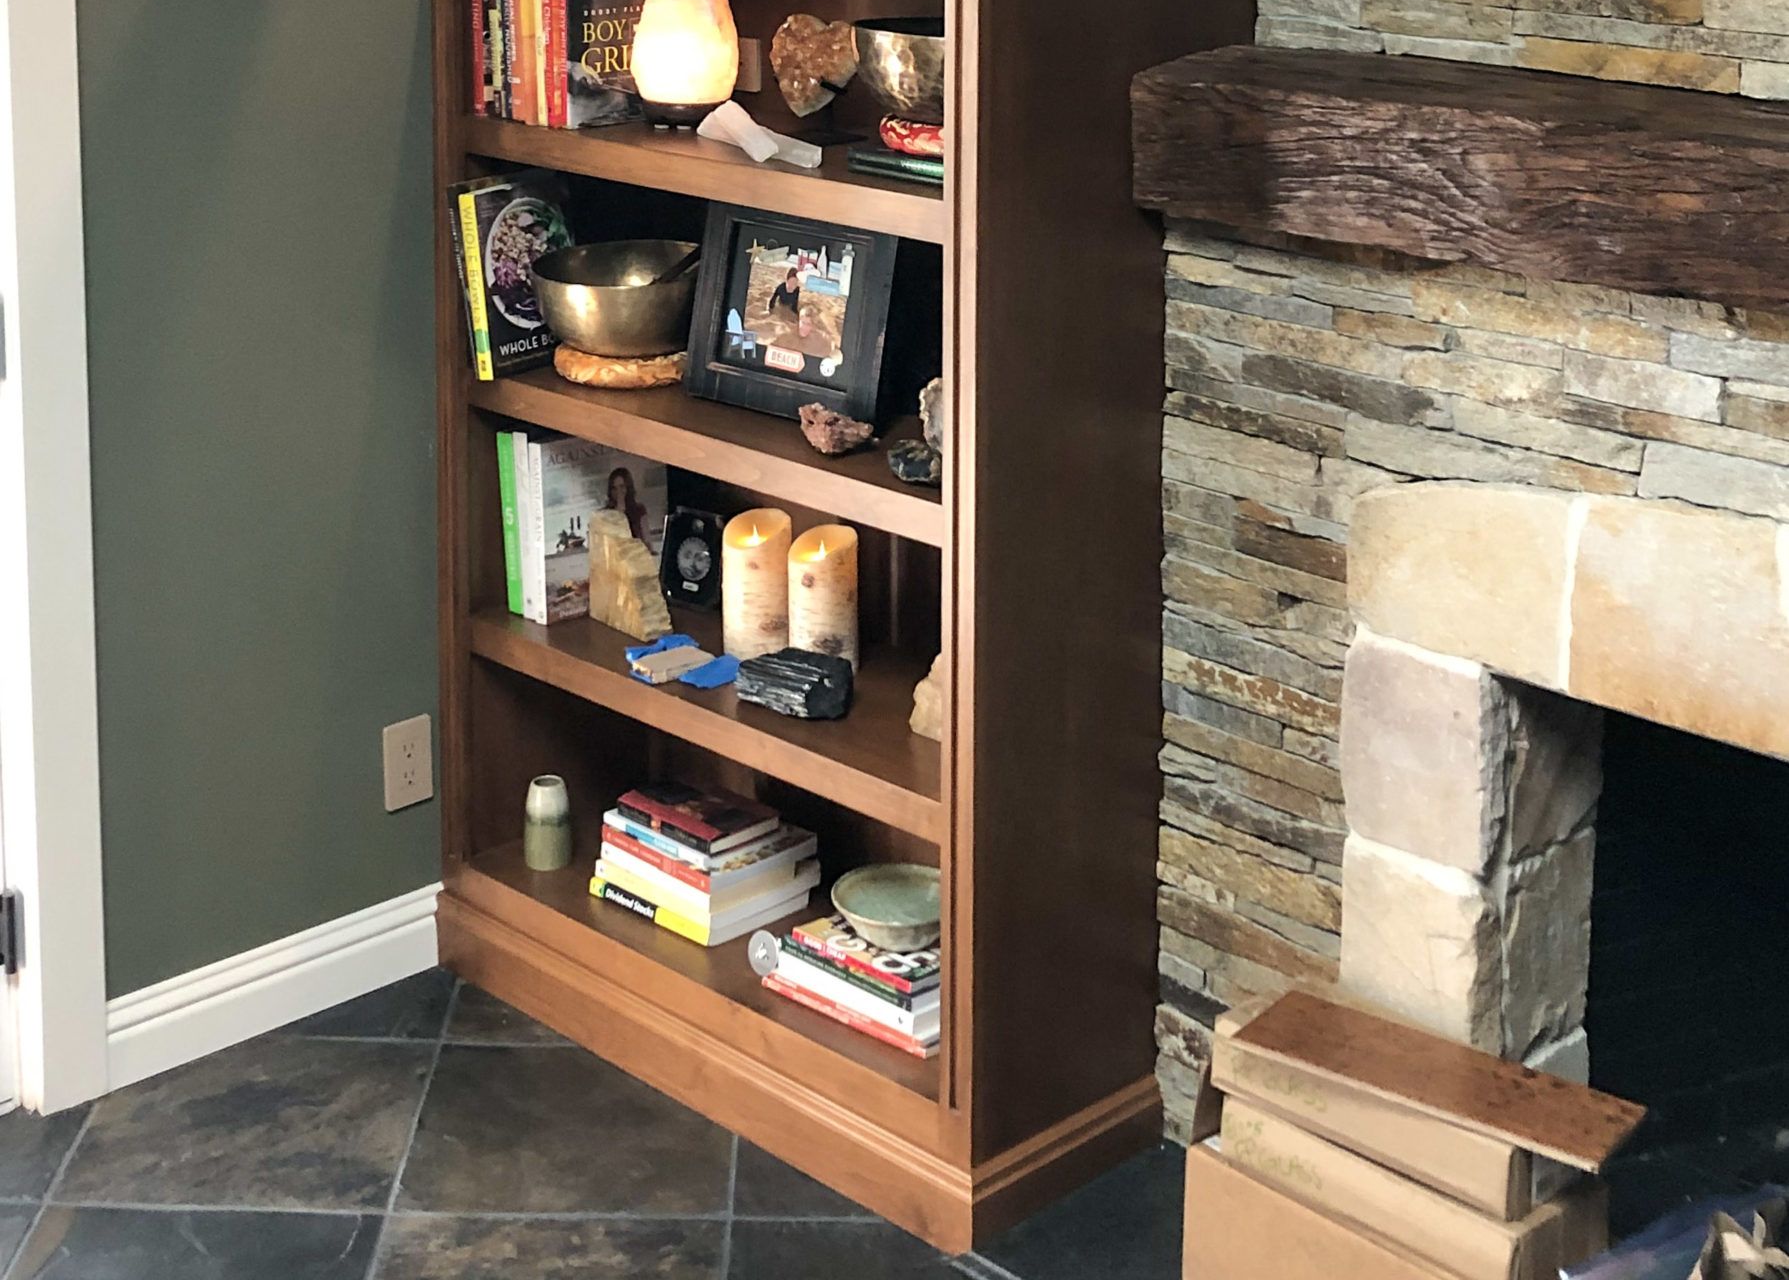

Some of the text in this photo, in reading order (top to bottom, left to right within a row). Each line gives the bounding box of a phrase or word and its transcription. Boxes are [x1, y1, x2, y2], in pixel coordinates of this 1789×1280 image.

[623, 5, 640, 14] FLA
[582, 19, 627, 44] BOY
[581, 44, 632, 77] GRI
[462, 206, 479, 266] WHOLE
[499, 336, 539, 356] WHOLE
[771, 351, 797, 366] BEACH
[505, 508, 513, 525] 5
[605, 888, 655, 919] Dividend Stocks
